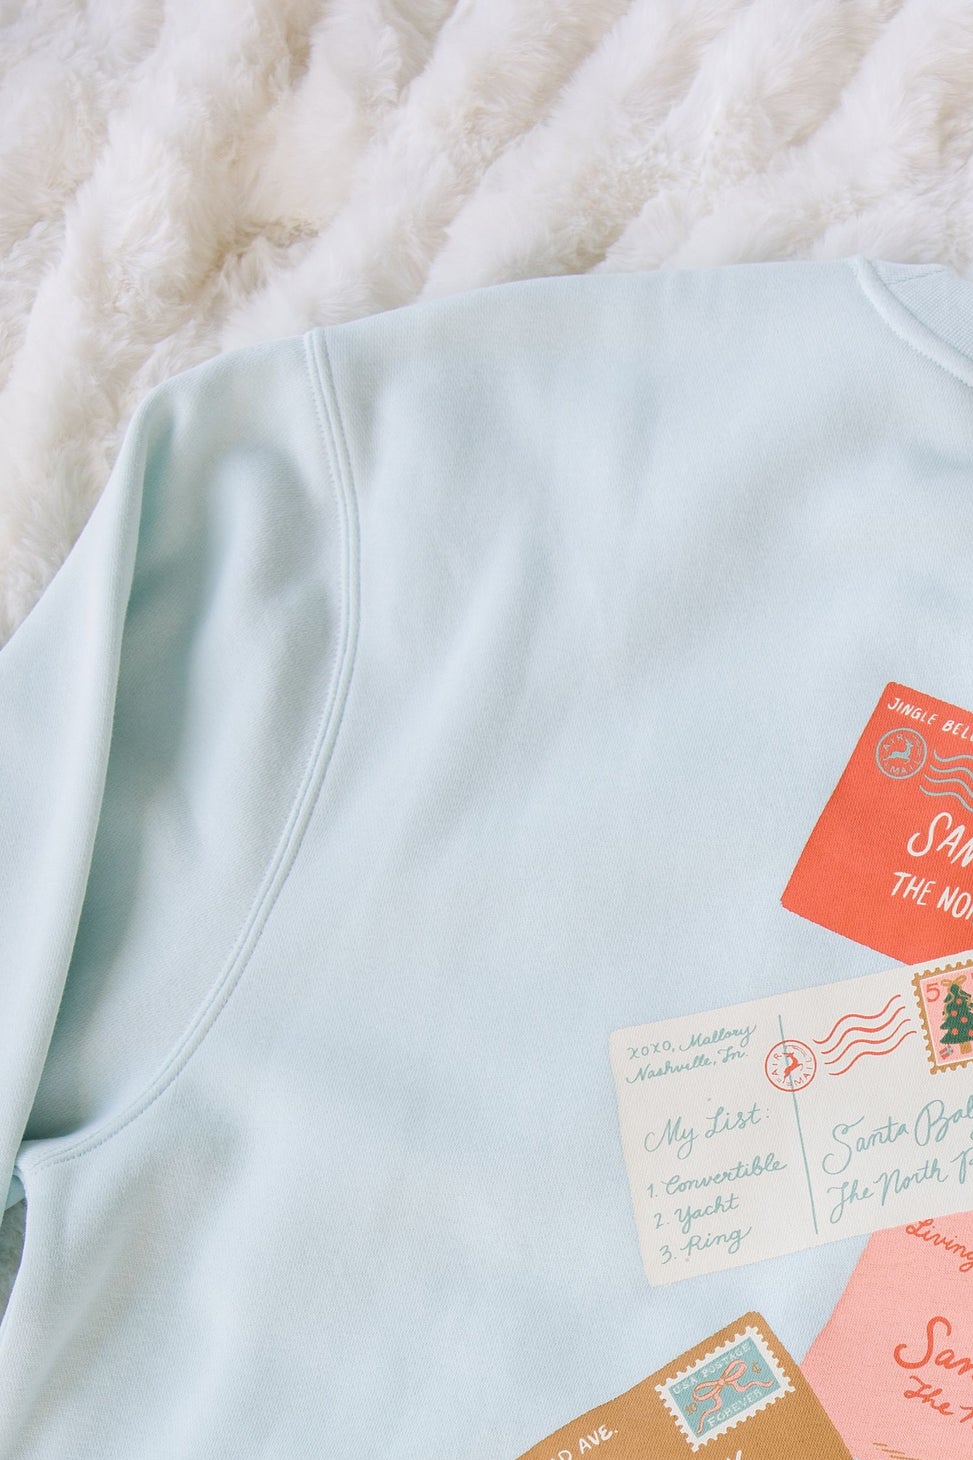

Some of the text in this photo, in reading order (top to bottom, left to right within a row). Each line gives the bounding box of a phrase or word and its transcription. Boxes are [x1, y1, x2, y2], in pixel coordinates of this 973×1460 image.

[888, 697, 939, 724] JINGLE
[891, 872, 935, 907] THE
[926, 983, 940, 1002] 5
[679, 1024, 756, 1048] Mallory
[644, 1116, 698, 1160] My
[823, 1116, 908, 1175] Santa
[665, 1153, 788, 1196] Convertible
[827, 1178, 874, 1224] The
[877, 1157, 949, 1206] North
[654, 1193, 739, 1234] 2. Yacht
[660, 1227, 752, 1264] 3. Ring
[672, 1343, 750, 1394] USA POSTAGE
[708, 1389, 762, 1427] FOREVER
[903, 1376, 954, 1416] The
[578, 1424, 619, 1454] AVE.
